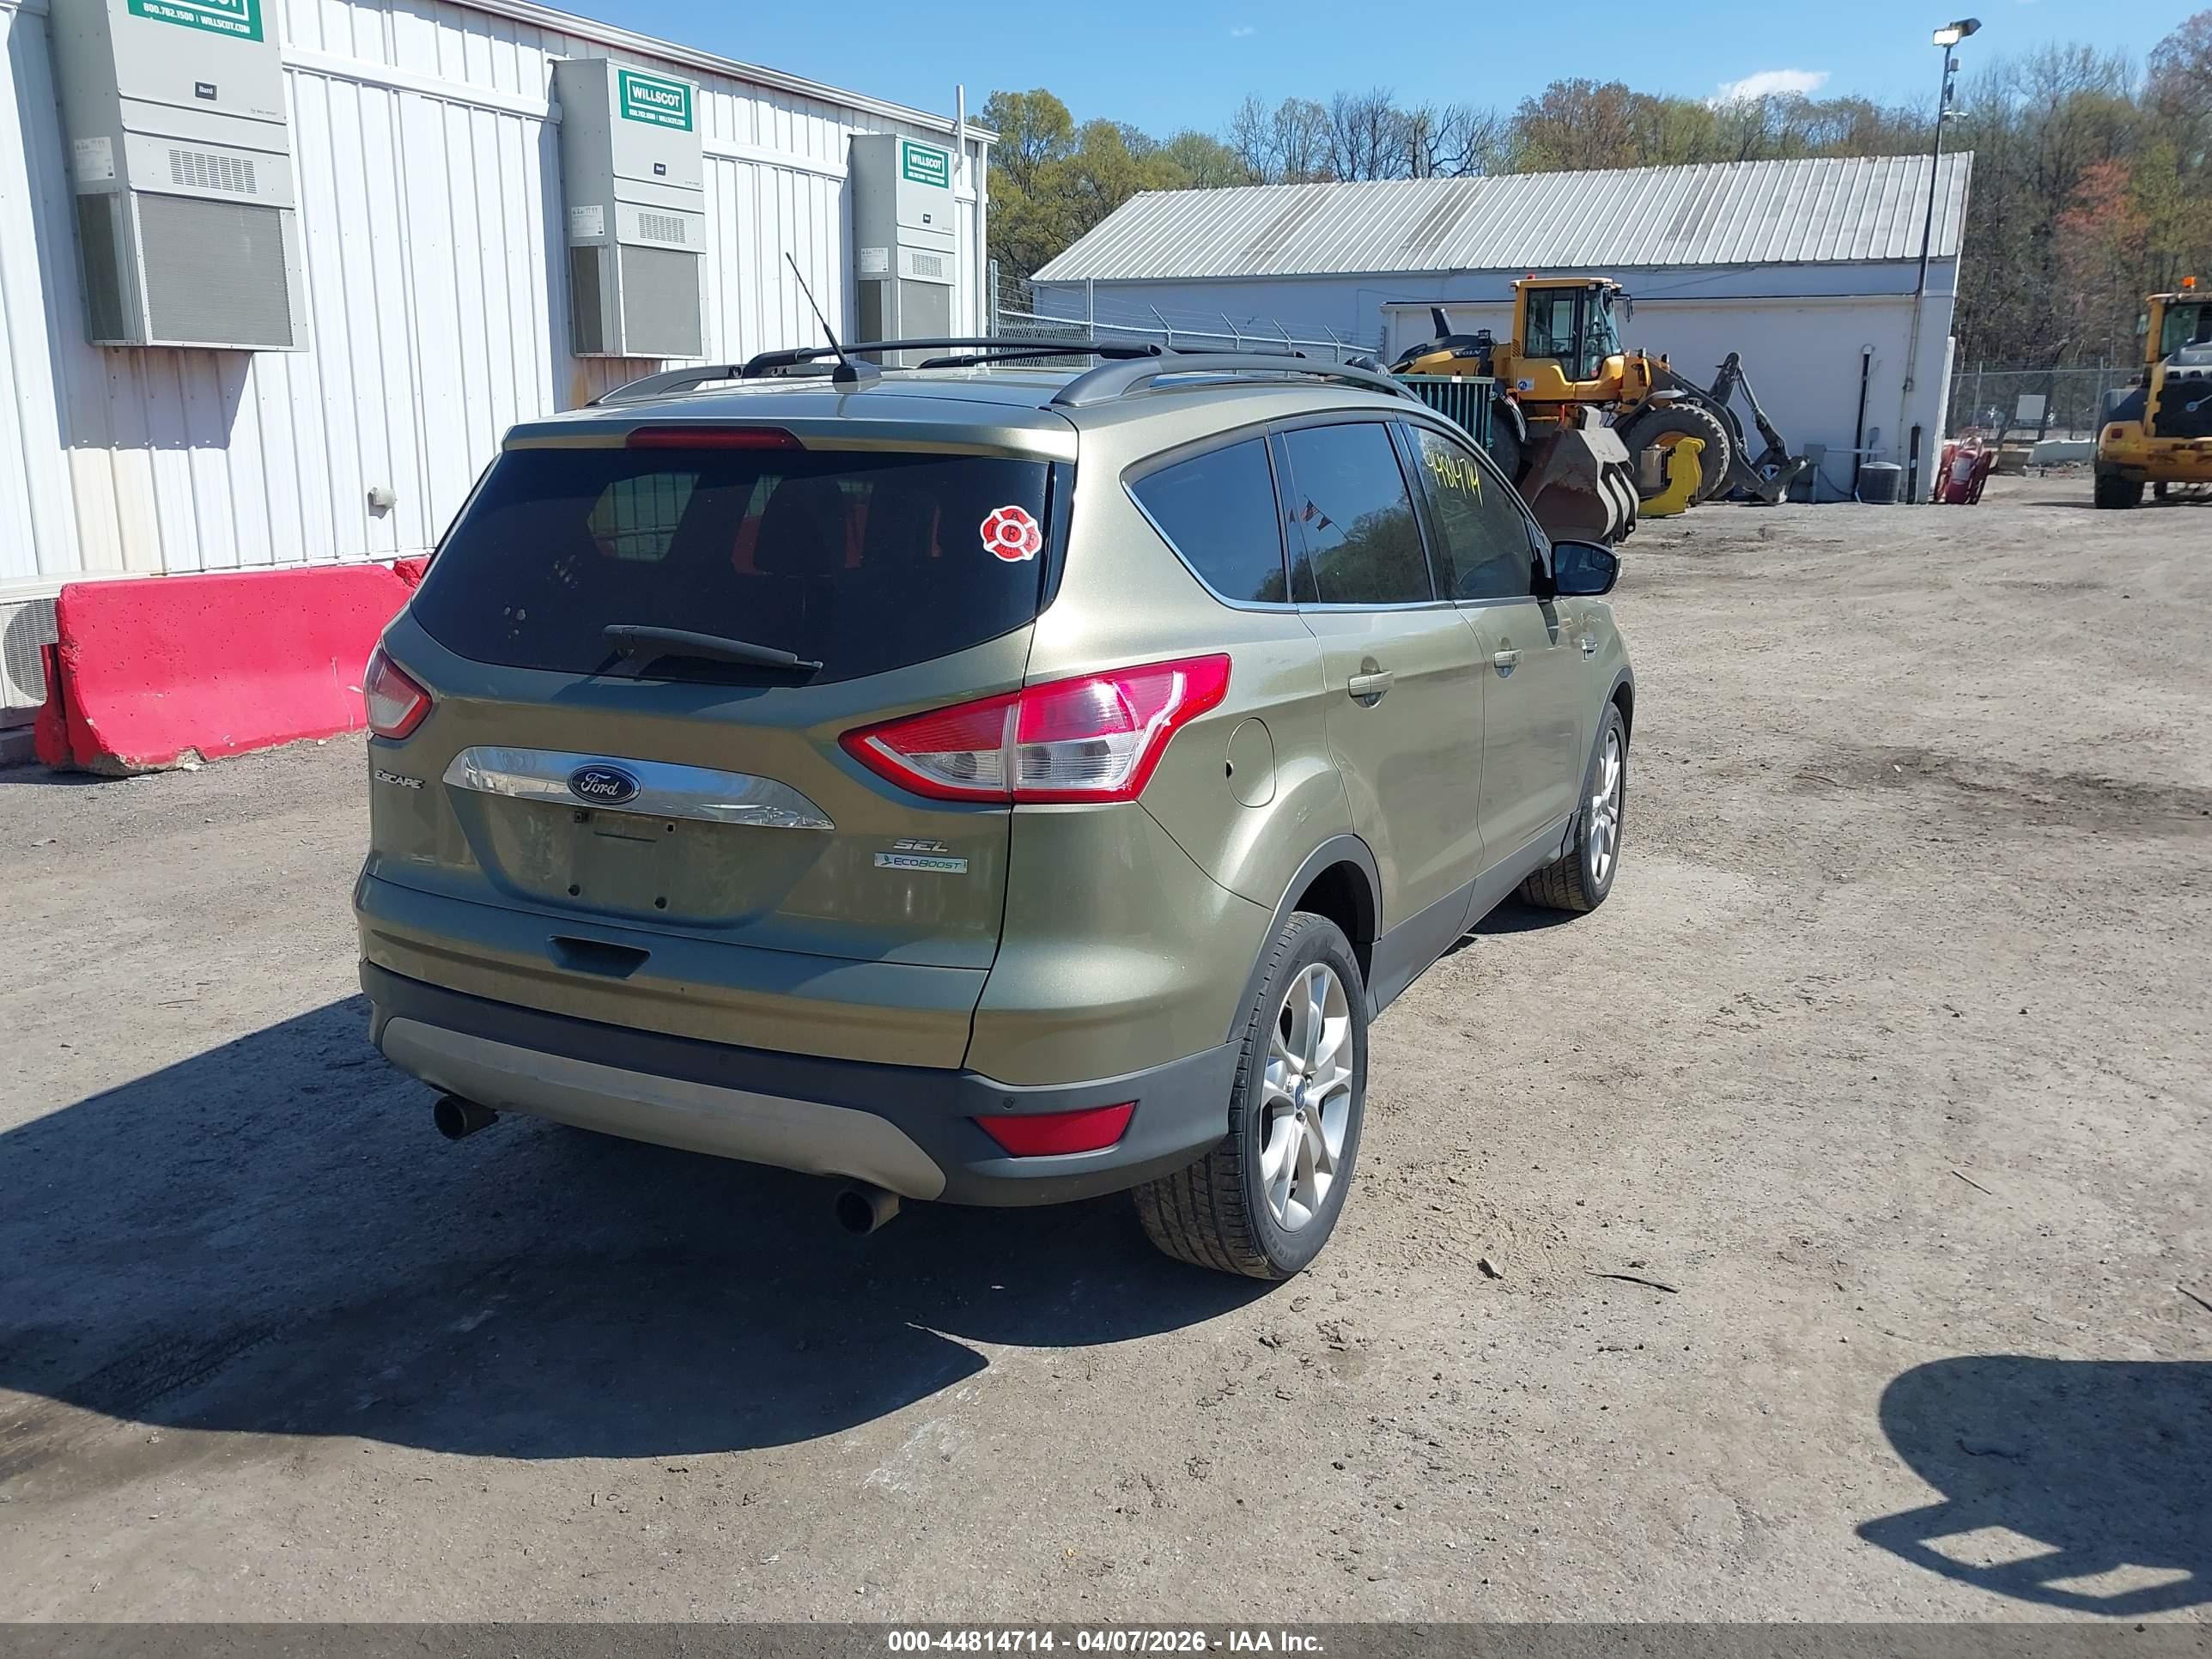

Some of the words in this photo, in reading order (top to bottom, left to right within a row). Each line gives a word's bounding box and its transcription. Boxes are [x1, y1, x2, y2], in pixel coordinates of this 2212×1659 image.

[143, 3, 195, 22] 800.782.1500
[200, 15, 251, 33] WILLSCOT.COM
[631, 85, 680, 109] WILLSCOT
[910, 152, 942, 171] WILLSCOT
[374, 769, 425, 789] ESCAPE
[580, 772, 620, 796] Ford
[893, 838, 949, 853] SEL
[893, 857, 963, 870] ECOBOOST
